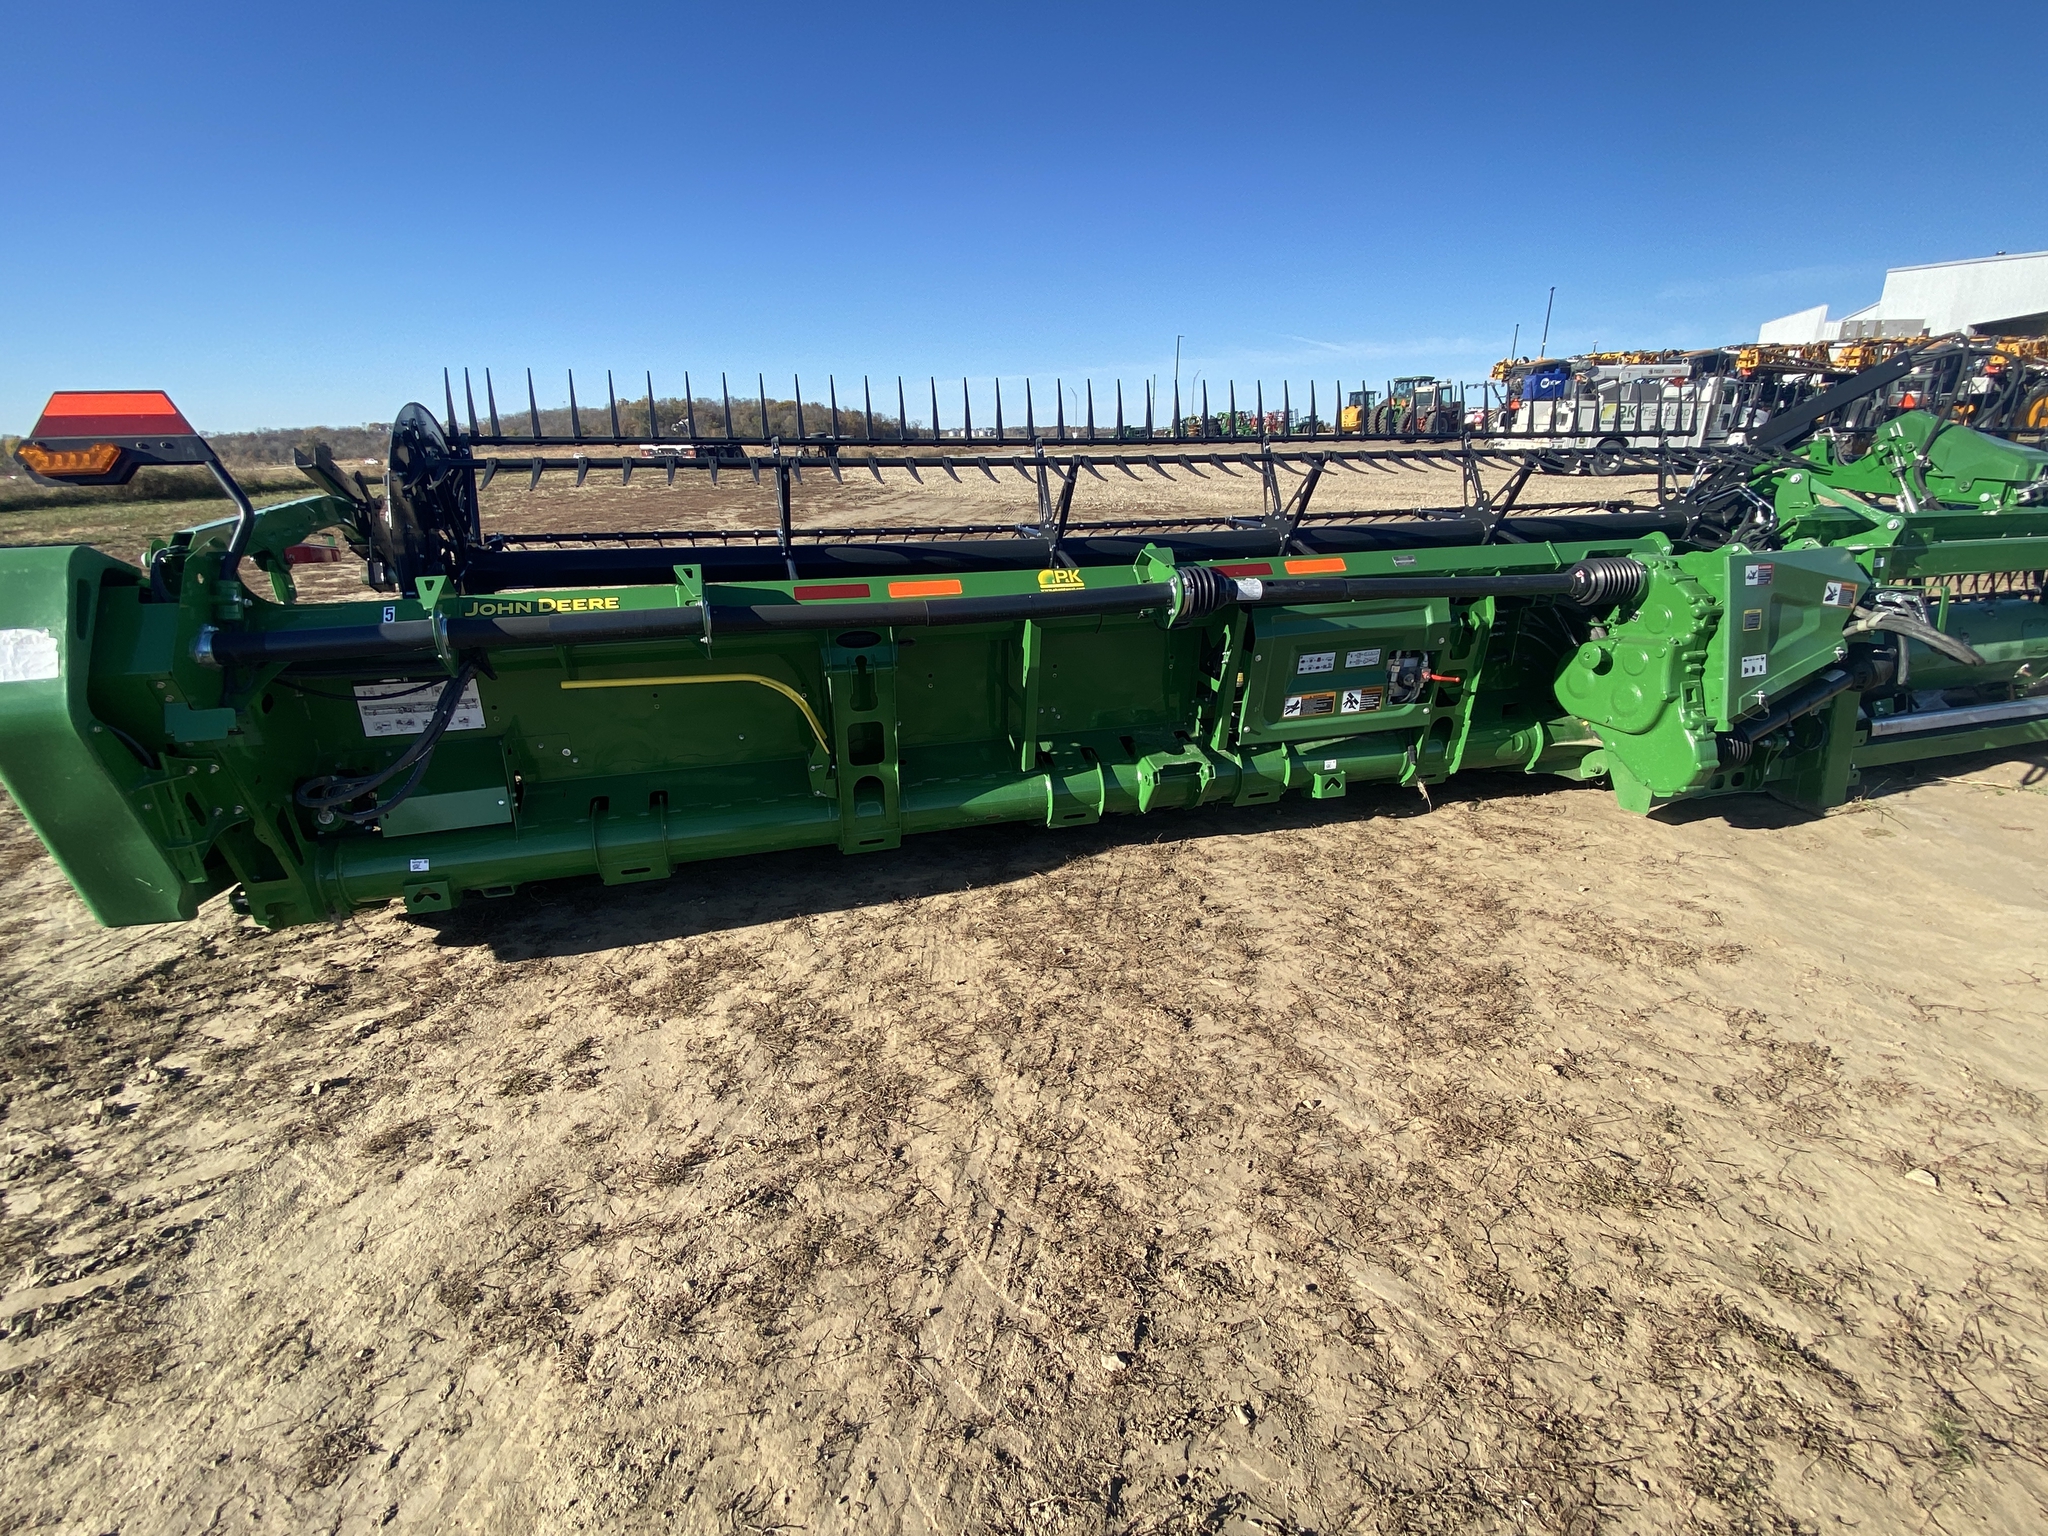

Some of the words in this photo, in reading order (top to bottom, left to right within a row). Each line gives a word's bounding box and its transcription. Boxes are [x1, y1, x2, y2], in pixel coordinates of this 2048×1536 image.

[385, 607, 394, 622] 5
[464, 601, 532, 617] JOHN
[537, 597, 620, 613] DEERE
